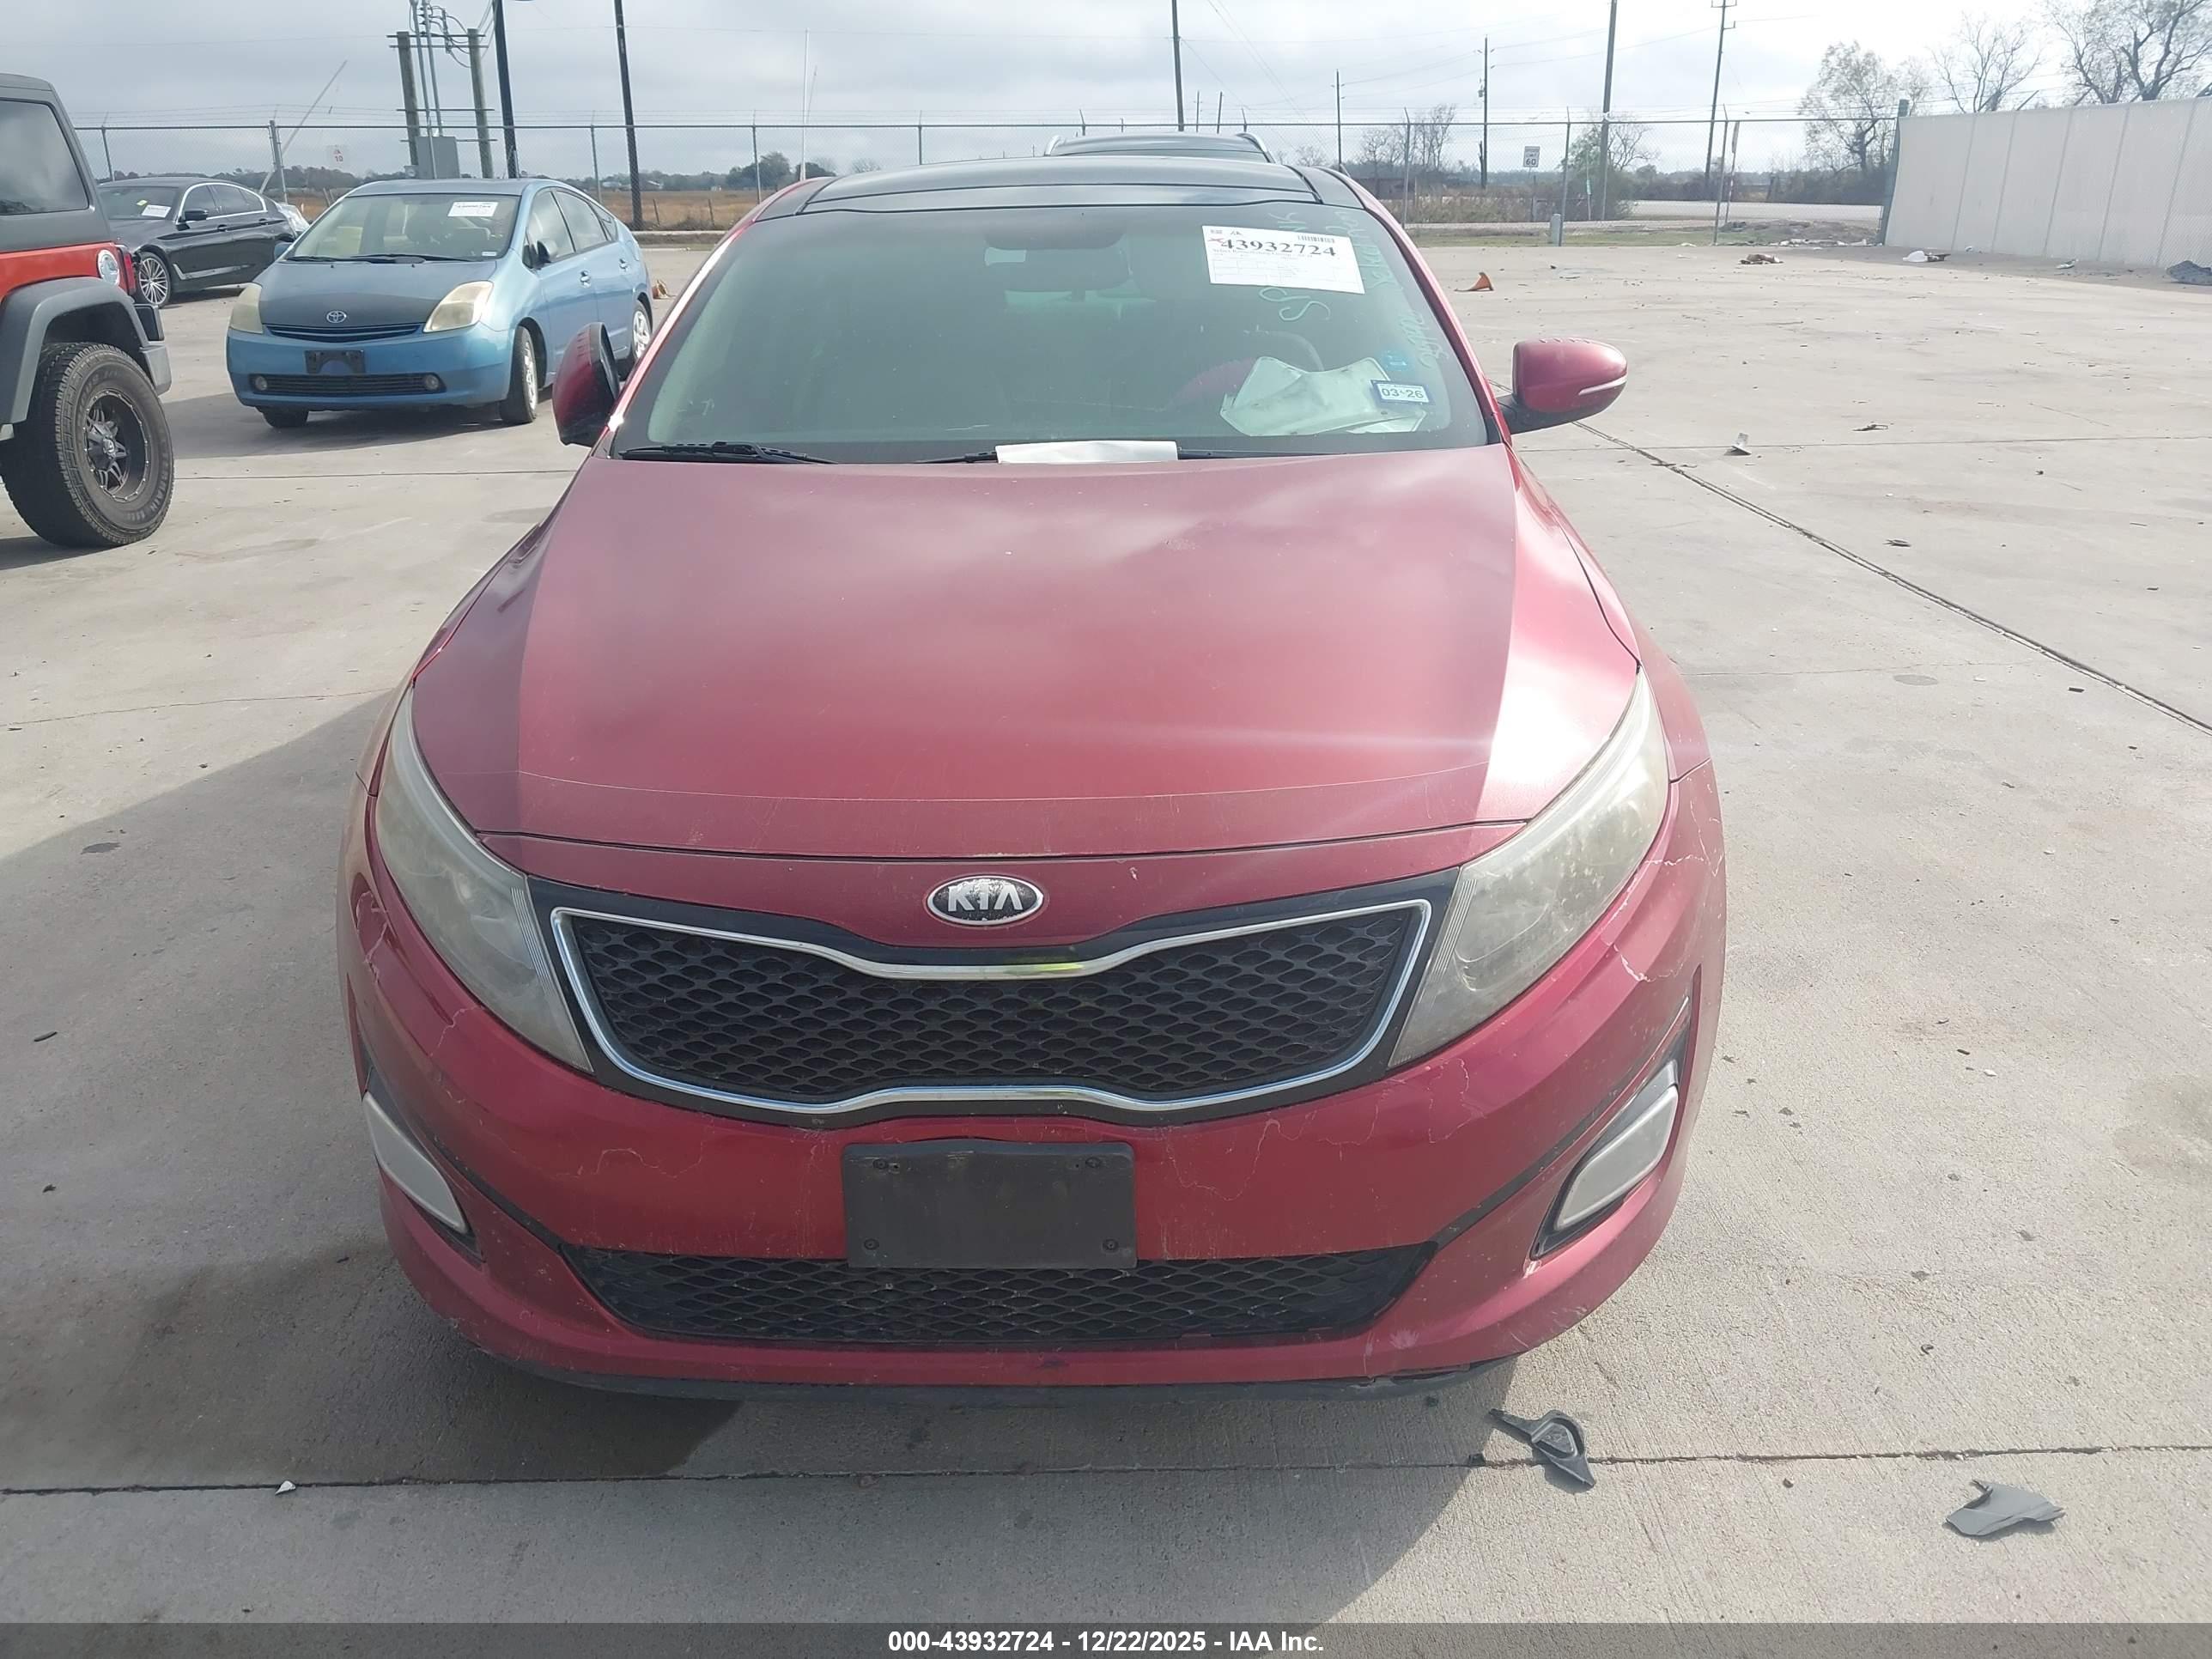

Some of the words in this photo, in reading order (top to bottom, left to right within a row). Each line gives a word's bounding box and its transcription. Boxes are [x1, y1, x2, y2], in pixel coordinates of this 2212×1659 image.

[1220, 239, 1336, 257] 43932724
[1382, 388, 1400, 397] 03
[1406, 389, 1425, 398] 26
[947, 881, 1024, 912] KIA
